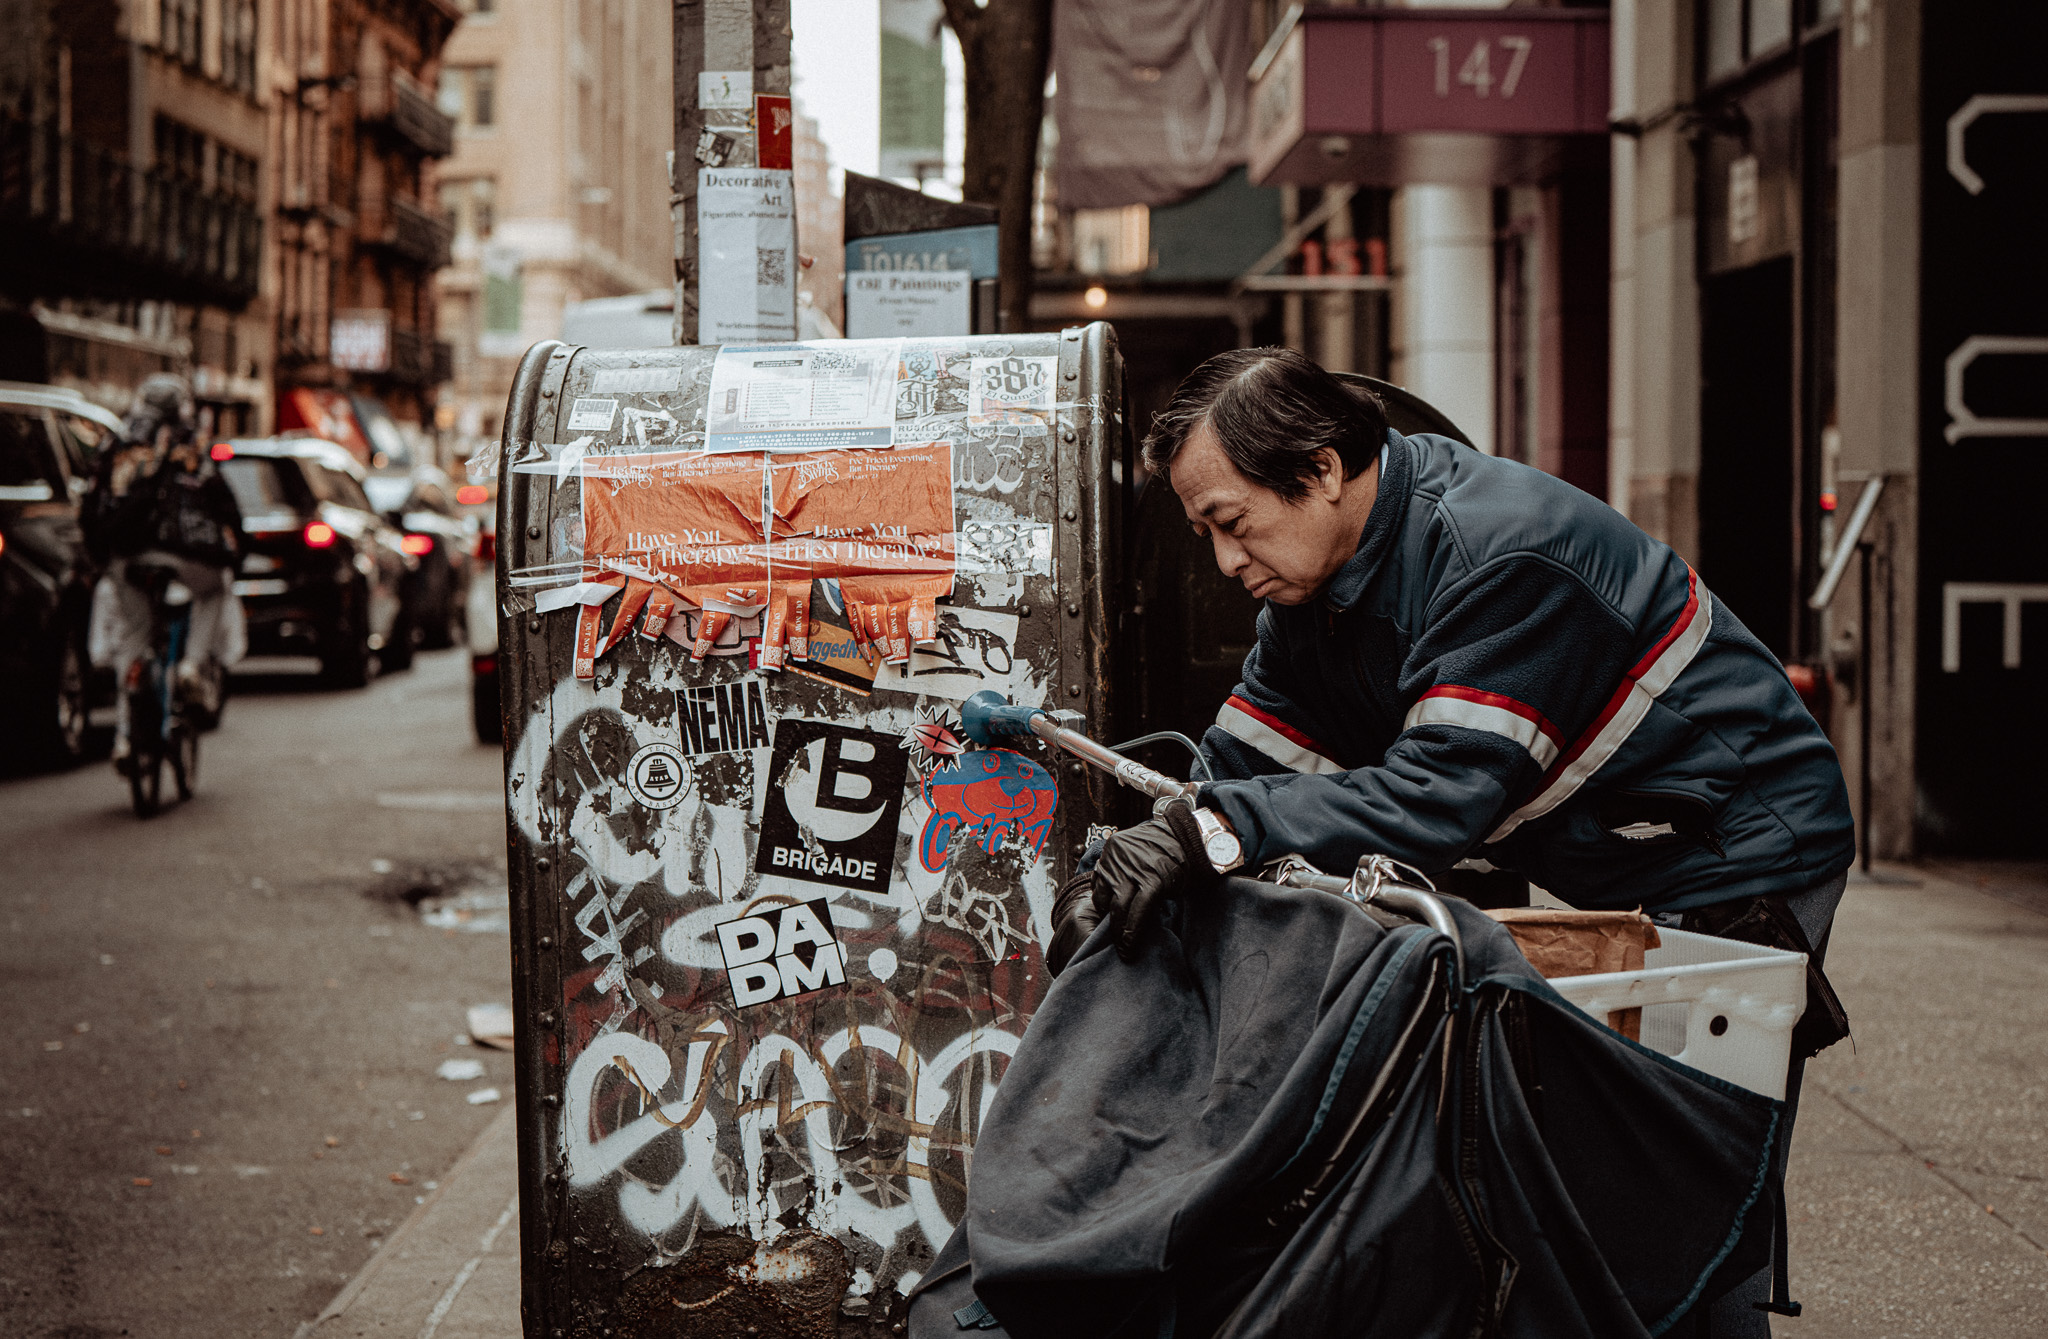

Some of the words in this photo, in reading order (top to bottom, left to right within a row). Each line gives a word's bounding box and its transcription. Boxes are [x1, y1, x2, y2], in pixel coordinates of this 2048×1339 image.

[1427, 35, 1533, 99] 147
[706, 174, 782, 189] Decorative
[761, 193, 782, 206] Art
[856, 279, 882, 290] Oil
[889, 279, 961, 292] Paintings
[985, 357, 1042, 395] 387
[1000, 385, 1047, 401] Quinche
[679, 460, 701, 470] Tried
[702, 458, 746, 470] Everything
[865, 456, 888, 464] Tried
[889, 453, 934, 464] Everything
[678, 469, 712, 478] Therapy
[849, 465, 863, 473] But
[865, 463, 899, 473] Therapy
[815, 524, 864, 539] Have
[870, 522, 907, 539] You
[628, 532, 676, 550] Have
[683, 528, 720, 545] You
[599, 551, 651, 573] Tried
[657, 544, 754, 567] Therapy?
[783, 542, 838, 560] Tried
[848, 540, 942, 562] Therapy?
[705, 621, 714, 636] NOW
[854, 623, 862, 640] NOW
[873, 618, 881, 634] NOW
[891, 618, 899, 635] NOW
[772, 627, 780, 643] NOW
[583, 638, 591, 654] NOW
[675, 681, 771, 755] NEMA
[630, 752, 644, 770] ALL
[648, 746, 686, 765] TELCOS
[649, 774, 669, 782] ATAB
[648, 780, 690, 808] BASTARDS
[772, 846, 878, 882] BRIGADE
